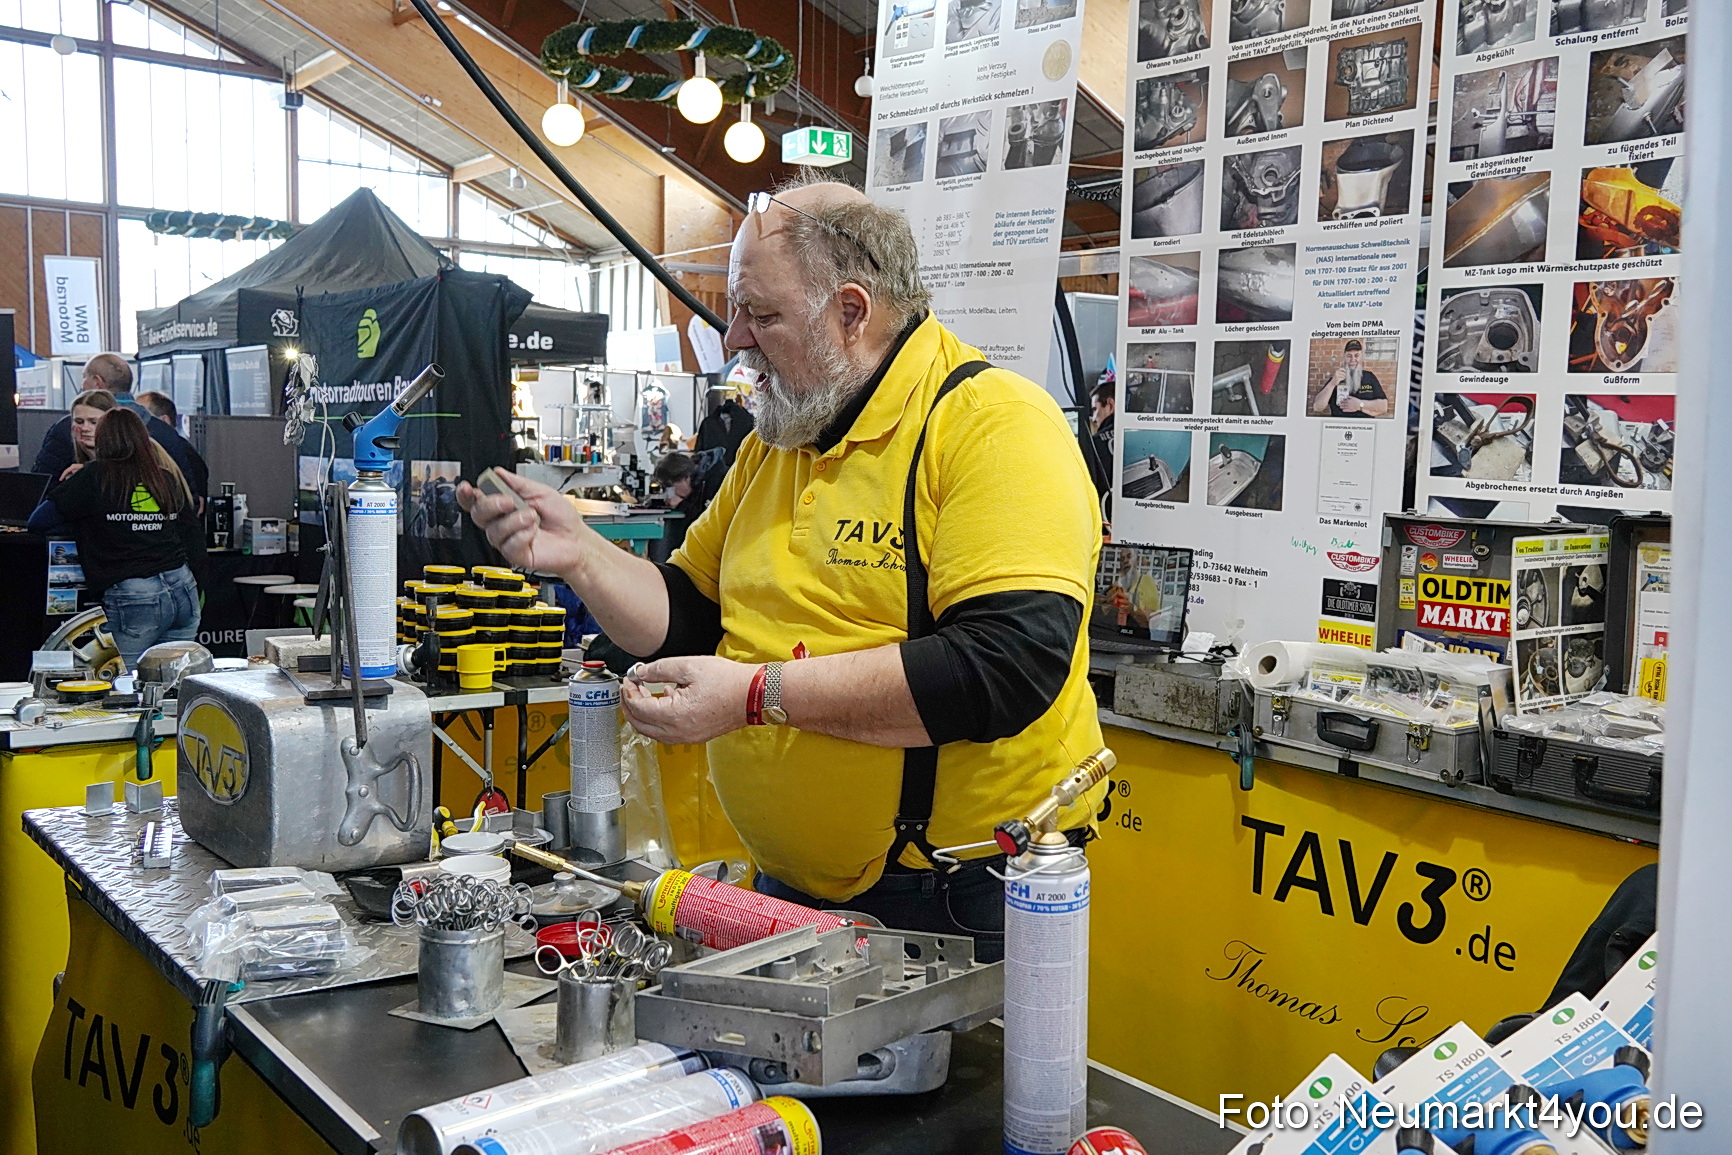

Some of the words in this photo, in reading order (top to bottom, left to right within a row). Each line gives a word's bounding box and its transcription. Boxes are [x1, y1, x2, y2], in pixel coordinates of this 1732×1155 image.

[1245, 41, 1262, 49] unten
[1264, 34, 1291, 46] Schraube
[1293, 25, 1329, 40] eingedreht,
[1339, 21, 1350, 29] die
[1352, 18, 1365, 27] Nut
[1367, 14, 1386, 23] einen
[1388, 6, 1419, 18] Stahlkeil
[1228, 53, 1239, 61] und
[1241, 49, 1252, 57] mit
[1304, 29, 1354, 45] Herumgedreht,
[1357, 22, 1389, 34] Schraube
[1555, 33, 1598, 47] Schalung
[1601, 27, 1639, 40] entfernt
[1476, 48, 1514, 63] Abgekühlt
[1146, 61, 1170, 69] Ölwanne
[1173, 56, 1193, 65] Yamaha
[890, 105, 928, 118] Schmelzdraht
[929, 103, 939, 112] soll
[941, 97, 960, 110] durchs
[962, 93, 992, 106] Werkstück
[994, 88, 1029, 100] schmelzen
[1362, 116, 1393, 126] Dichtend
[1237, 137, 1256, 145] Außen
[1258, 135, 1269, 143] und
[1271, 131, 1287, 141] Innen
[1608, 147, 1618, 155] zu
[1621, 141, 1659, 154] fügendes
[1662, 137, 1677, 148] Teil
[1135, 150, 1170, 160] nachgebohrt
[1628, 151, 1654, 161] fixiert
[1158, 156, 1182, 165] schnitten
[1466, 162, 1478, 171] mit
[1480, 155, 1533, 170] abgewinkelter
[1471, 164, 1526, 179] Gewindestange
[1031, 208, 1056, 216] Betriebs-
[1323, 222, 1362, 231] verschliffen
[1380, 218, 1403, 227] poliert
[1004, 228, 1034, 238] gezogenen
[1243, 228, 1284, 238] Edelstahlblech
[1019, 237, 1048, 245] zertifiziert
[1153, 239, 1180, 247] Korrodiert
[1241, 238, 1274, 247] eingeschalt
[1305, 243, 1359, 252] Normenausschuss
[1361, 238, 1410, 249] Schweißtechnik
[1316, 256, 1333, 264] (NAS)
[1335, 254, 1379, 262] internationale
[1465, 267, 1495, 277] MZ-Tank
[1497, 266, 1517, 276] Logo
[1520, 265, 1534, 274] mit
[1537, 262, 1619, 273] Wärmeschutzpaste
[1622, 259, 1662, 270] geschützt
[1357, 288, 1390, 296] zutreffend
[1225, 325, 1244, 333] Löcher
[1246, 325, 1279, 334] geschlossen
[1312, 330, 1359, 339] eingetragenen
[989, 344, 1015, 353] auftragen.
[1459, 376, 1509, 384] Gewindeauge
[1604, 376, 1640, 384] Gußform
[1465, 481, 1527, 493] Abgebrochenes
[1529, 484, 1557, 495] ersetzt
[1560, 486, 1583, 496] durch
[1585, 489, 1624, 499] Angießen
[1135, 501, 1175, 510] Ausgebrochenes
[1225, 509, 1263, 518] Ausgebessert
[132, 523, 162, 531] BAYERN
[1333, 519, 1368, 528] Markenlot
[1409, 527, 1459, 538] CUSTOMBIKE
[826, 548, 868, 567] Thomas
[1331, 554, 1376, 564] CUSTOMBIKE
[1203, 562, 1231, 572] D-73642
[1234, 566, 1268, 577] Welzheim
[1235, 578, 1247, 586] Fax
[1336, 600, 1359, 612] OLDTIMER
[1359, 603, 1373, 613] SHOW
[1421, 604, 1506, 632] MARKT
[1319, 627, 1371, 646] WHEELIE
[586, 690, 609, 699] CFH
[1048, 893, 1066, 901] 2000
[1205, 940, 1342, 1025] Thomas
[1554, 1031, 1572, 1045] TS
[1573, 1012, 1602, 1034] 1800
[1436, 1068, 1455, 1084] TS
[1455, 1048, 1486, 1072] 1800
[732, 1078, 743, 1096] 2000
[1315, 1109, 1334, 1126] TS
